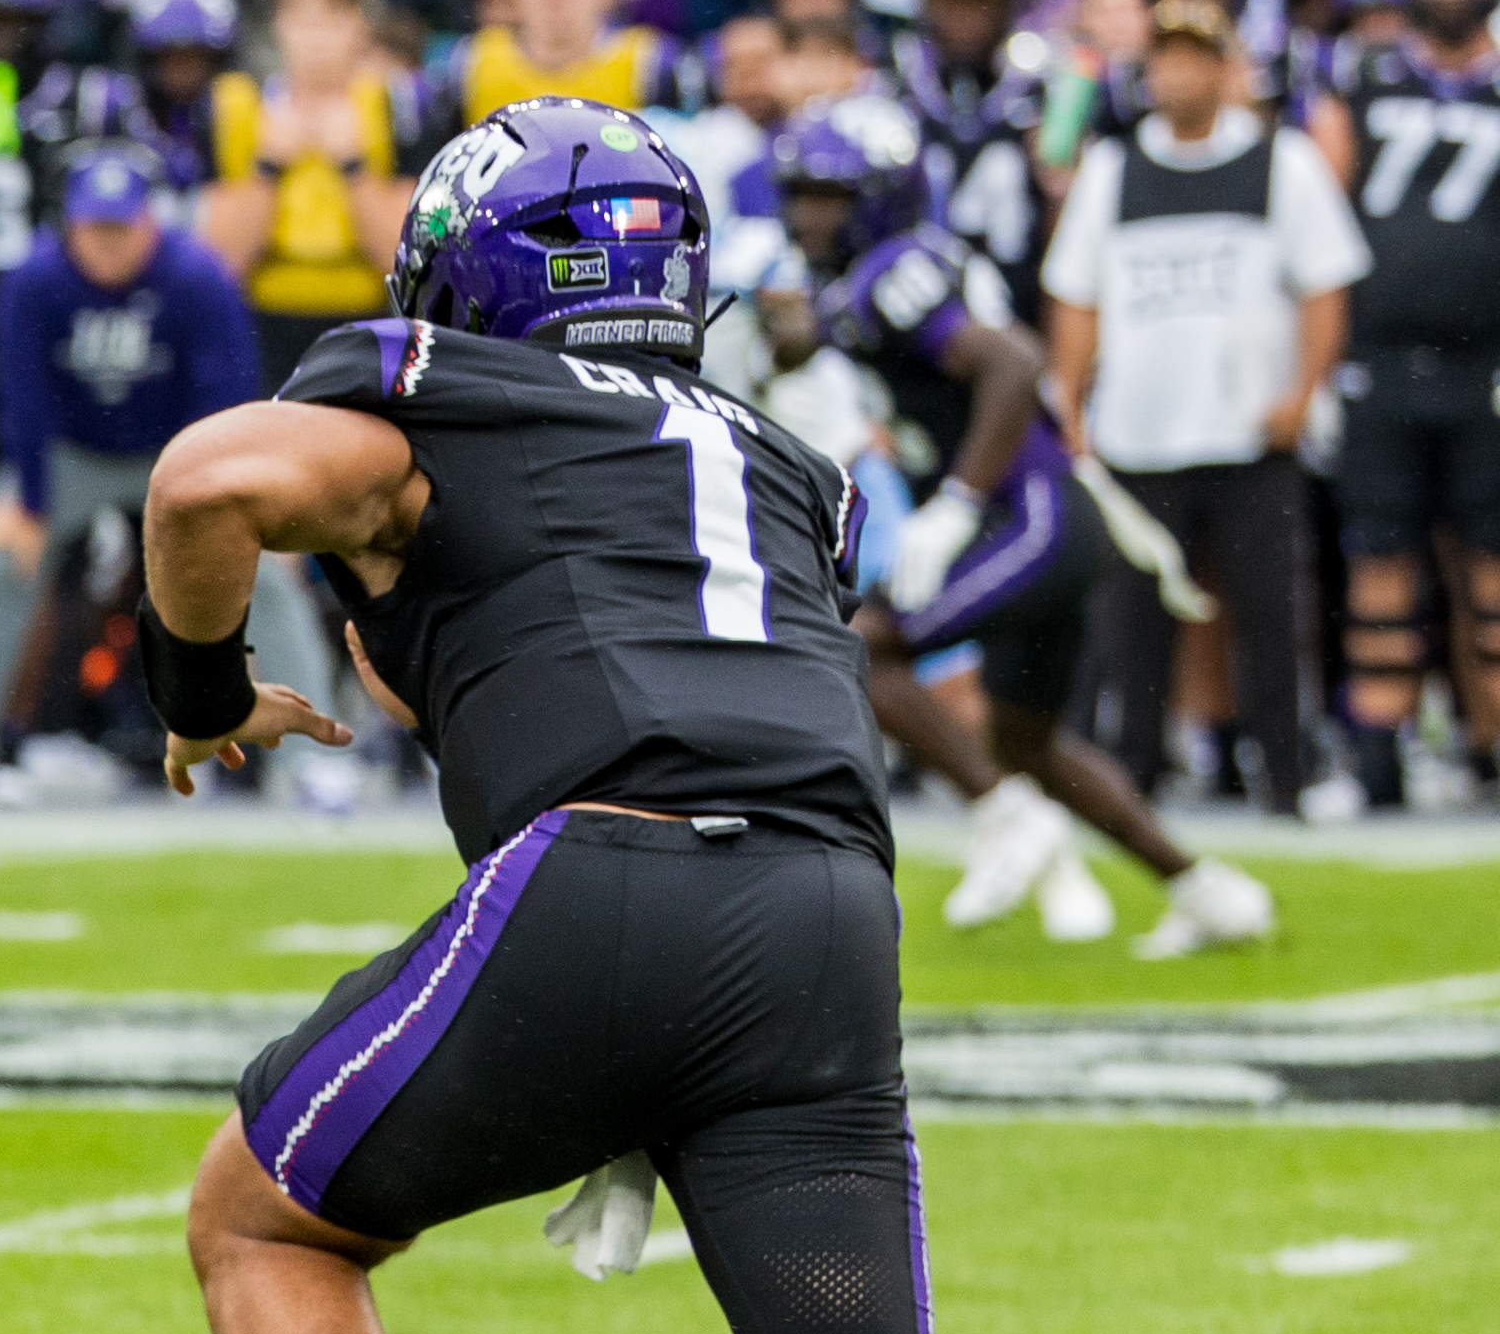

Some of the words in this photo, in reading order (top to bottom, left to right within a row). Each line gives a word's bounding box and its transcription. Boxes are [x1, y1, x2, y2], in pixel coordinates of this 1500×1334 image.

[1361, 97, 1500, 222] 77
[565, 320, 646, 346] HORNED
[560, 353, 760, 435] CRAIG
[654, 400, 771, 643] 1
